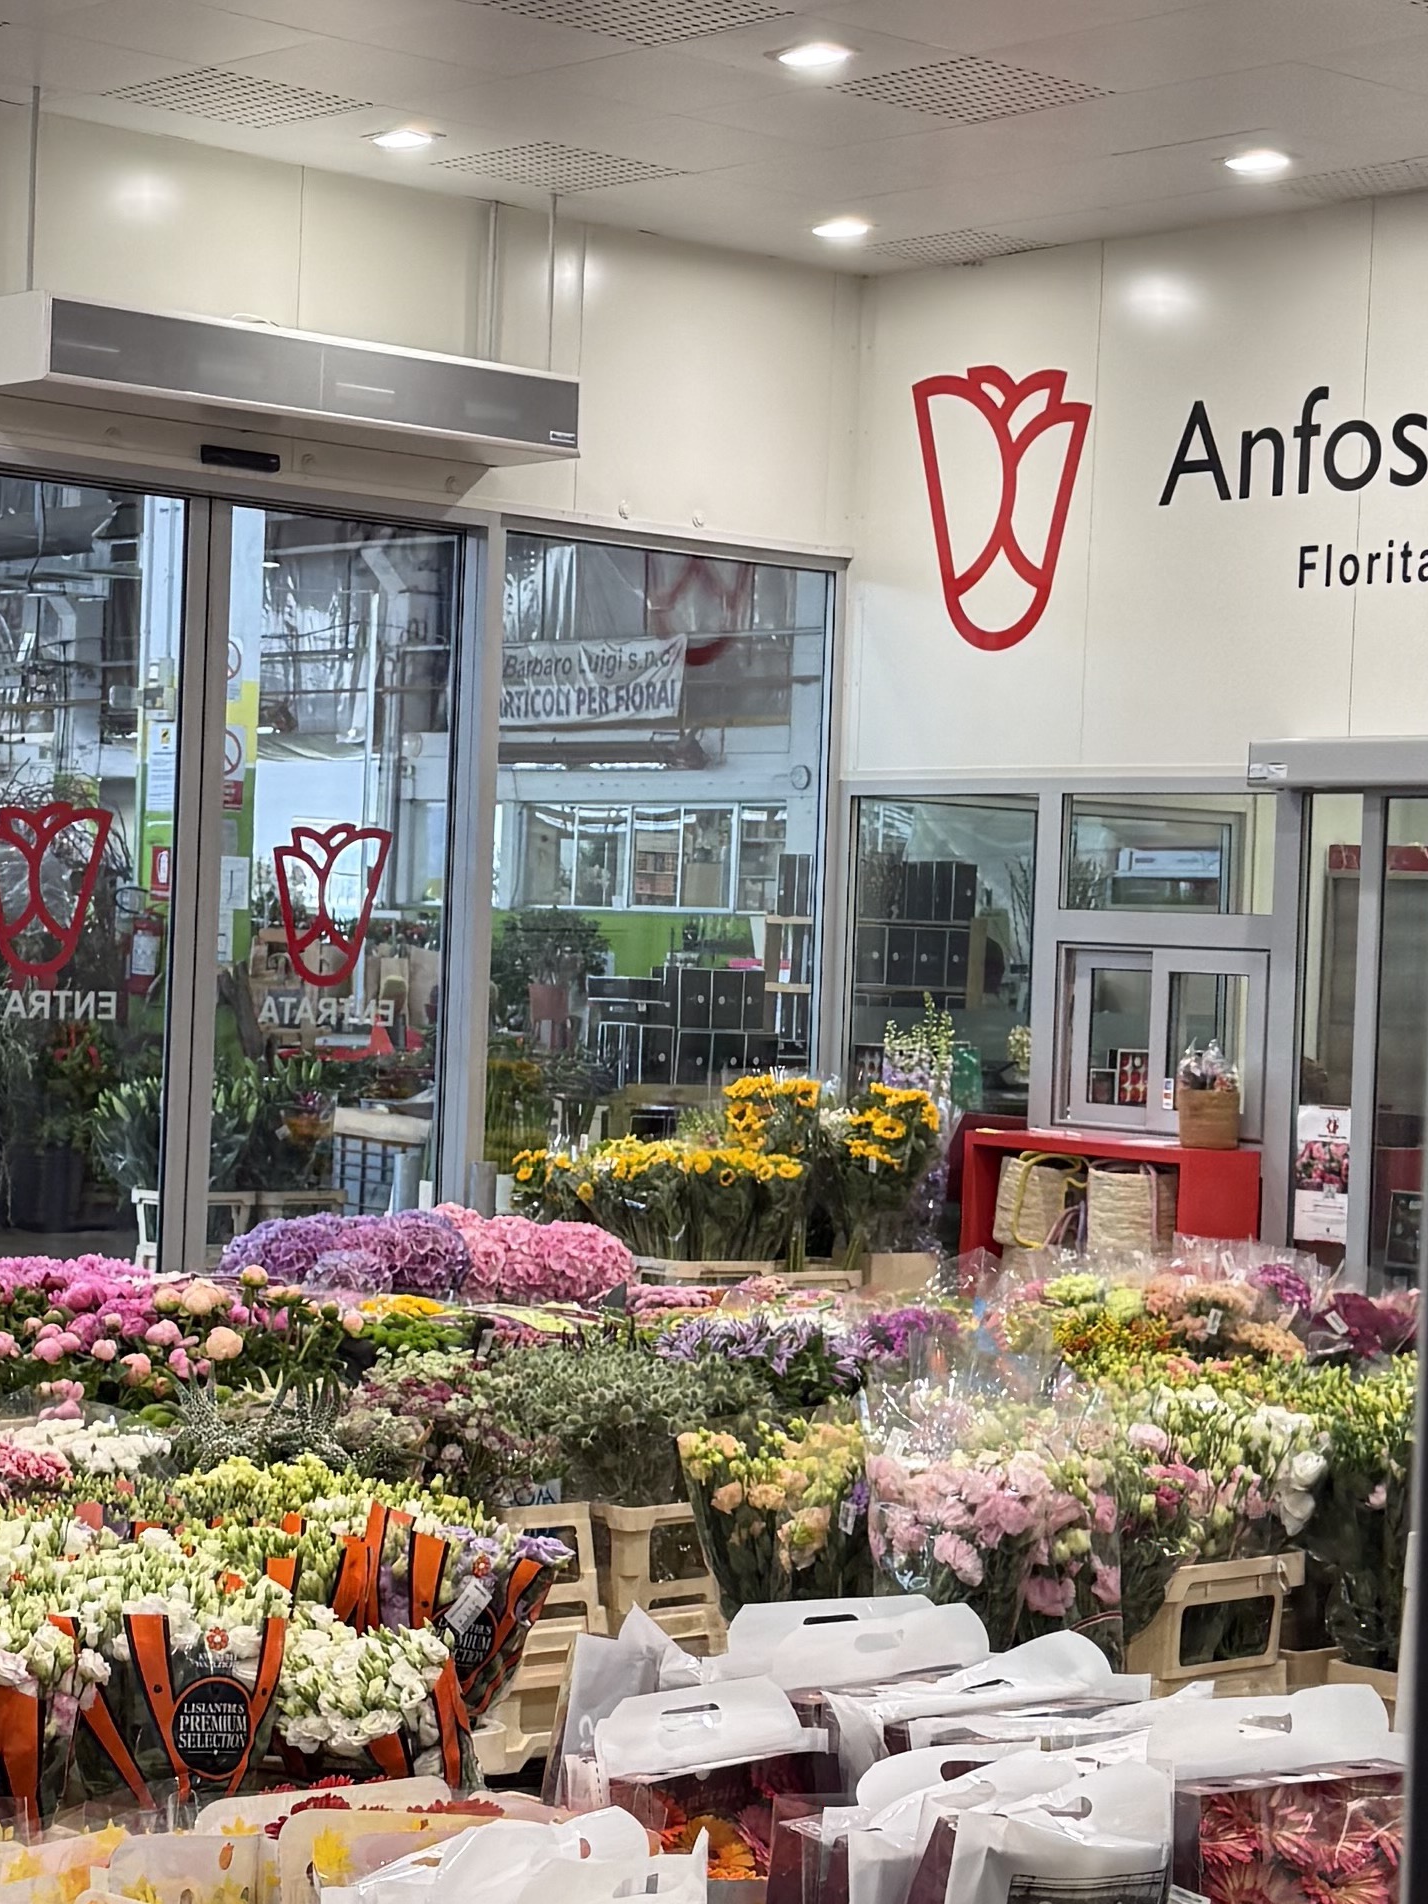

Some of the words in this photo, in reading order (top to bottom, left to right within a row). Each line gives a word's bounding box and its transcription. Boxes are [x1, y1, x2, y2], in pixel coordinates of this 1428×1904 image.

[502, 654, 572, 679] Barbaro
[576, 686, 609, 716] PER
[179, 1714, 247, 1732] PREMIUM
[178, 1733, 246, 1749] SELECTION
